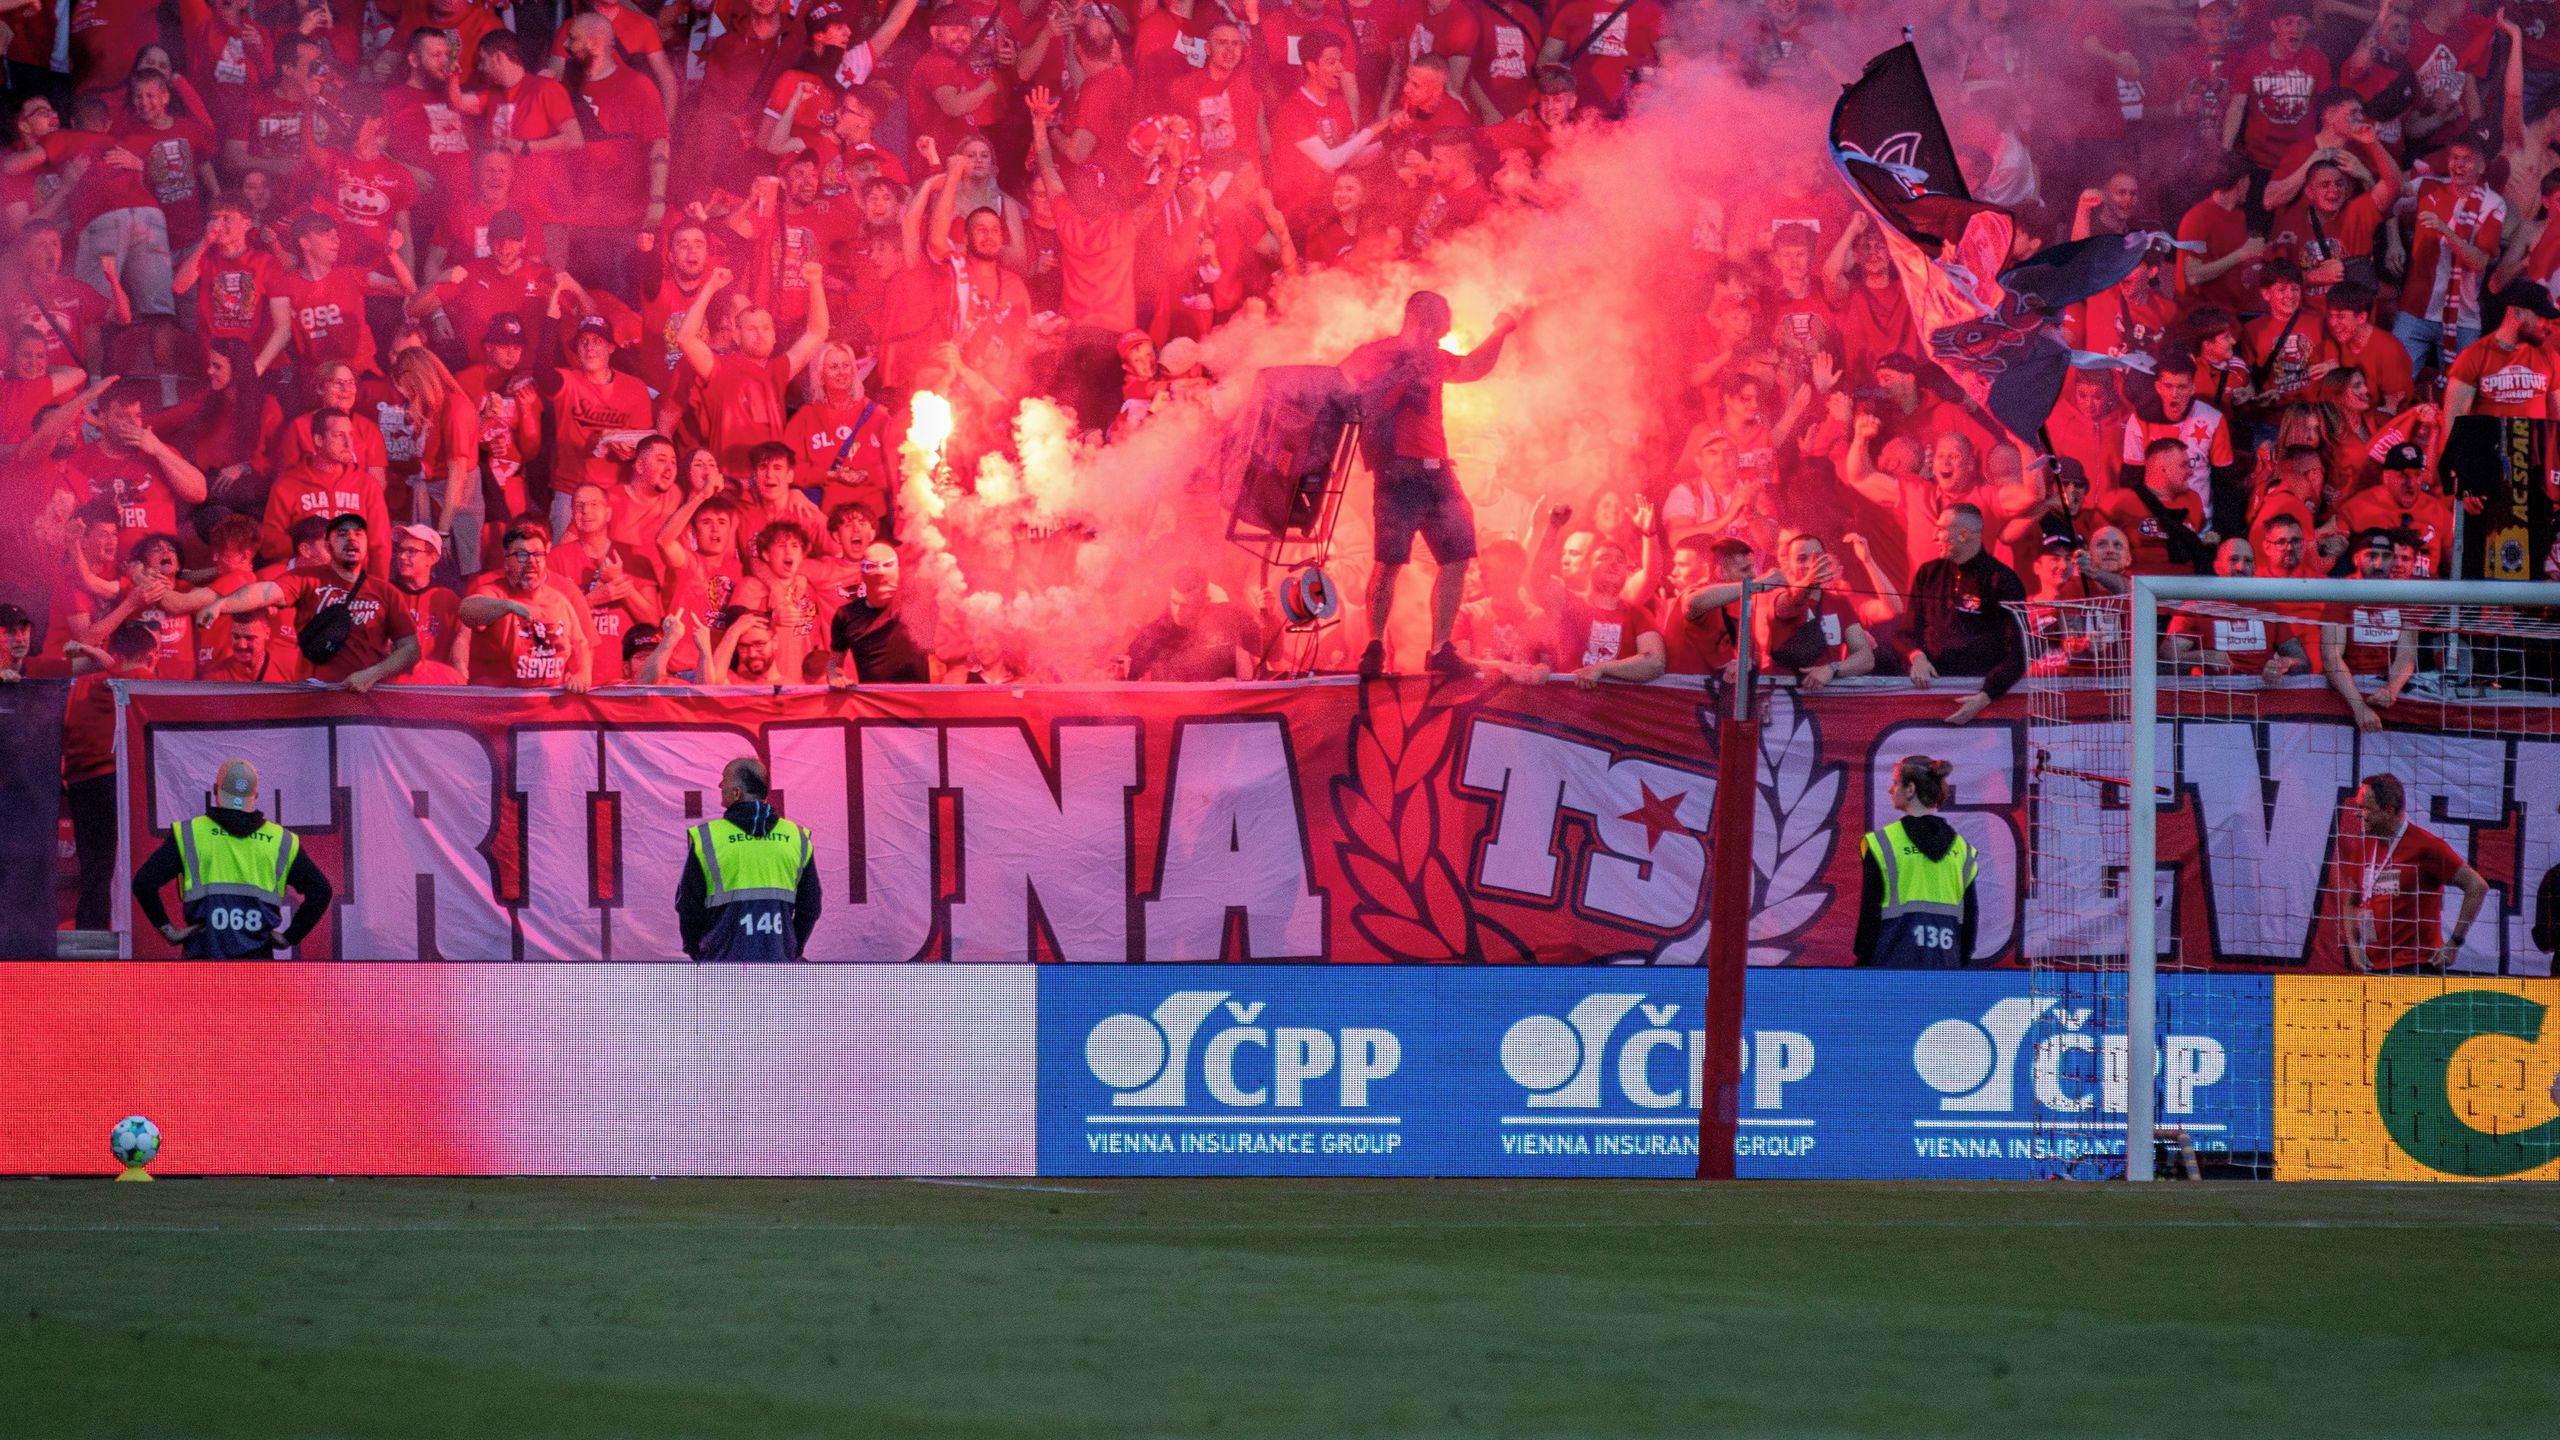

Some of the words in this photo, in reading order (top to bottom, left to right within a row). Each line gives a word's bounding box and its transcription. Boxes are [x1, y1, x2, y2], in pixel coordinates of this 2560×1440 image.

[291, 304, 344, 330] 892
[2511, 416, 2529, 486] SPAR
[211, 826, 275, 844] SEITY
[211, 907, 264, 932] 068
[739, 912, 783, 936] 146
[1913, 924, 1955, 950] 136
[1203, 1001, 1401, 1107] ČPP
[1087, 1132, 1174, 1154] VIENNA
[1181, 1132, 1315, 1154] INSURANCE
[1322, 1133, 1402, 1154] GROUP
[1501, 1134, 1588, 1156] VIENNA
[1595, 1135, 1700, 1156] INSURAN
[1734, 1135, 1816, 1156] GROUP
[1914, 1137, 2003, 1159] VIENNA
[2008, 1138, 2128, 1159] INSURANC
